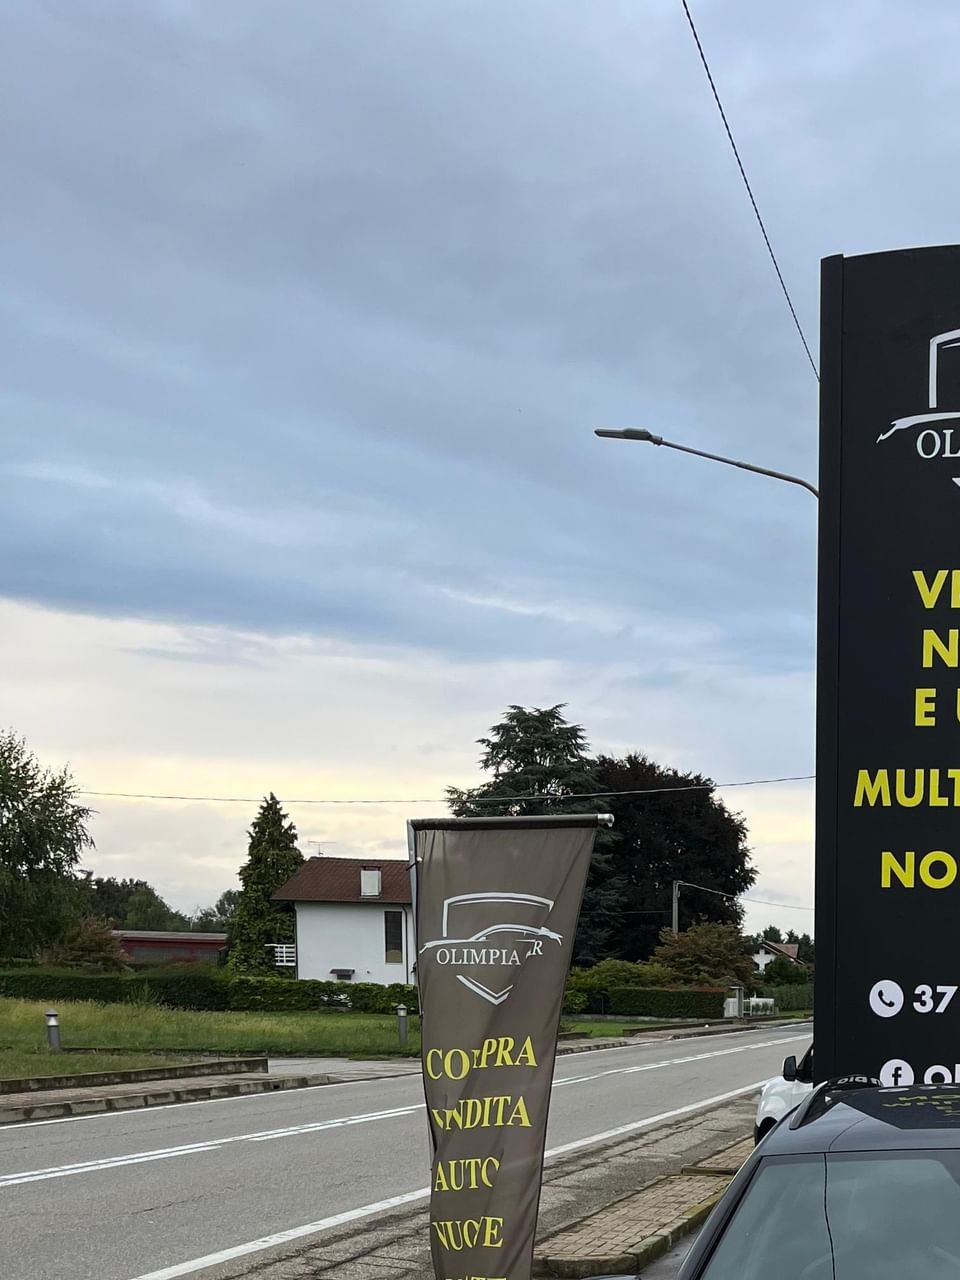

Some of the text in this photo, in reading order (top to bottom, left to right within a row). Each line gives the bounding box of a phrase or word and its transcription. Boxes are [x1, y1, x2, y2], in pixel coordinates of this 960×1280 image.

[914, 688, 937, 727] E
[436, 948, 521, 965] OLIMPIA
[432, 1095, 532, 1130] VNDITA
